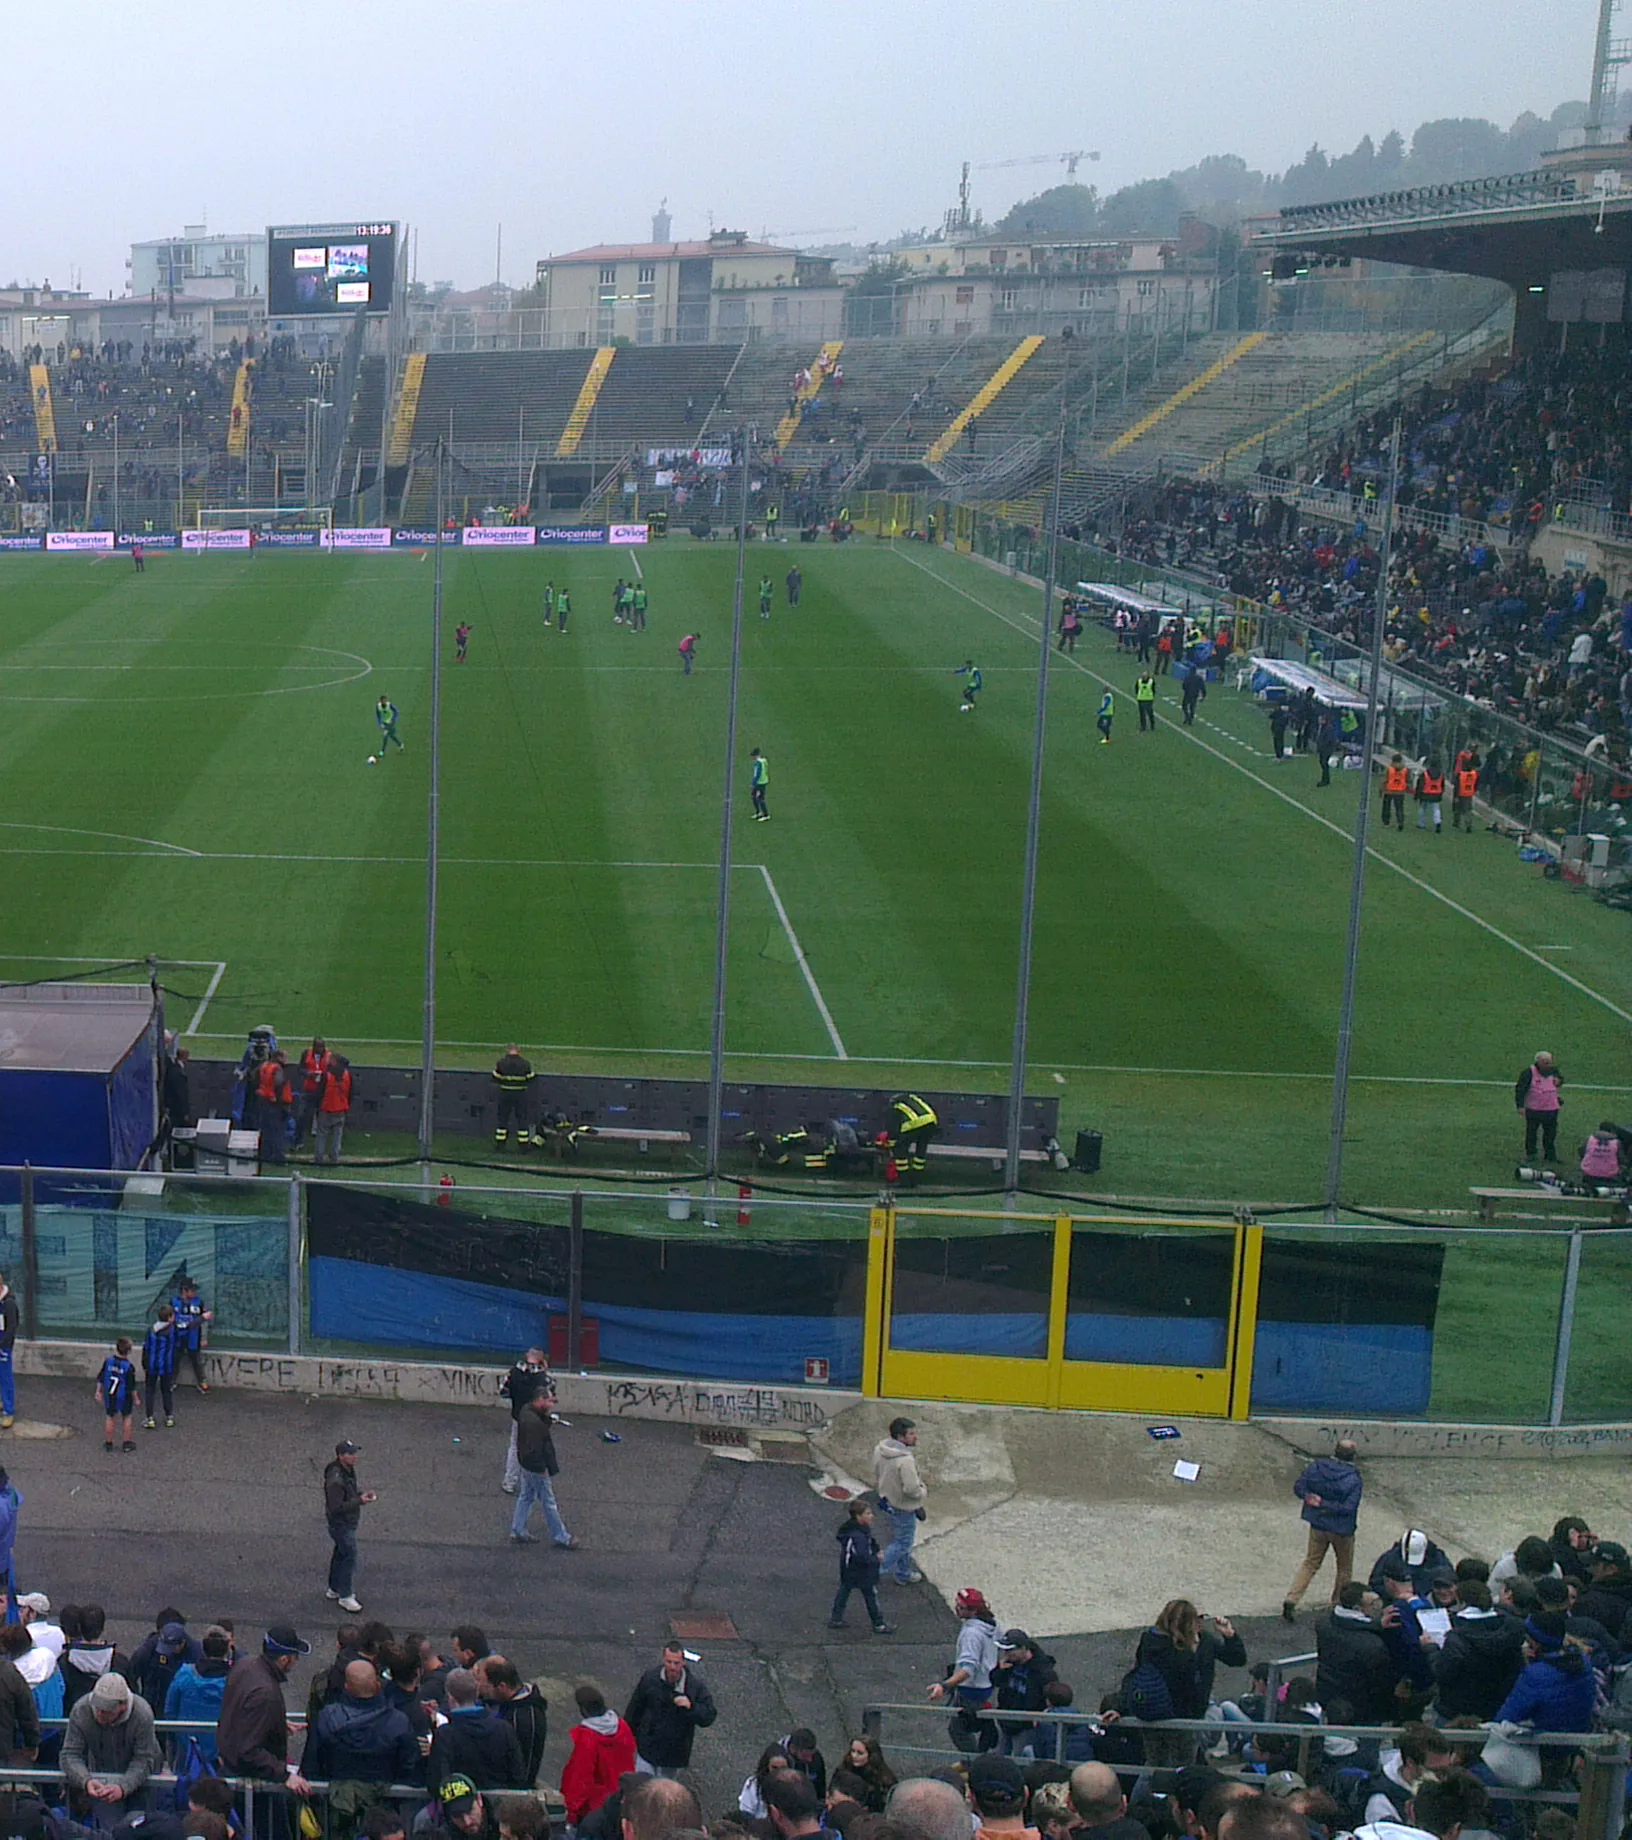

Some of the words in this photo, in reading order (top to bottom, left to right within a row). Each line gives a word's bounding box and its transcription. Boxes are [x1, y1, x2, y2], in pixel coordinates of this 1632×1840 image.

[51, 535, 108, 545] Oriocenter
[396, 530, 457, 542] Orioceter
[467, 530, 530, 541] Oriocenter
[109, 1375, 120, 1395] 7
